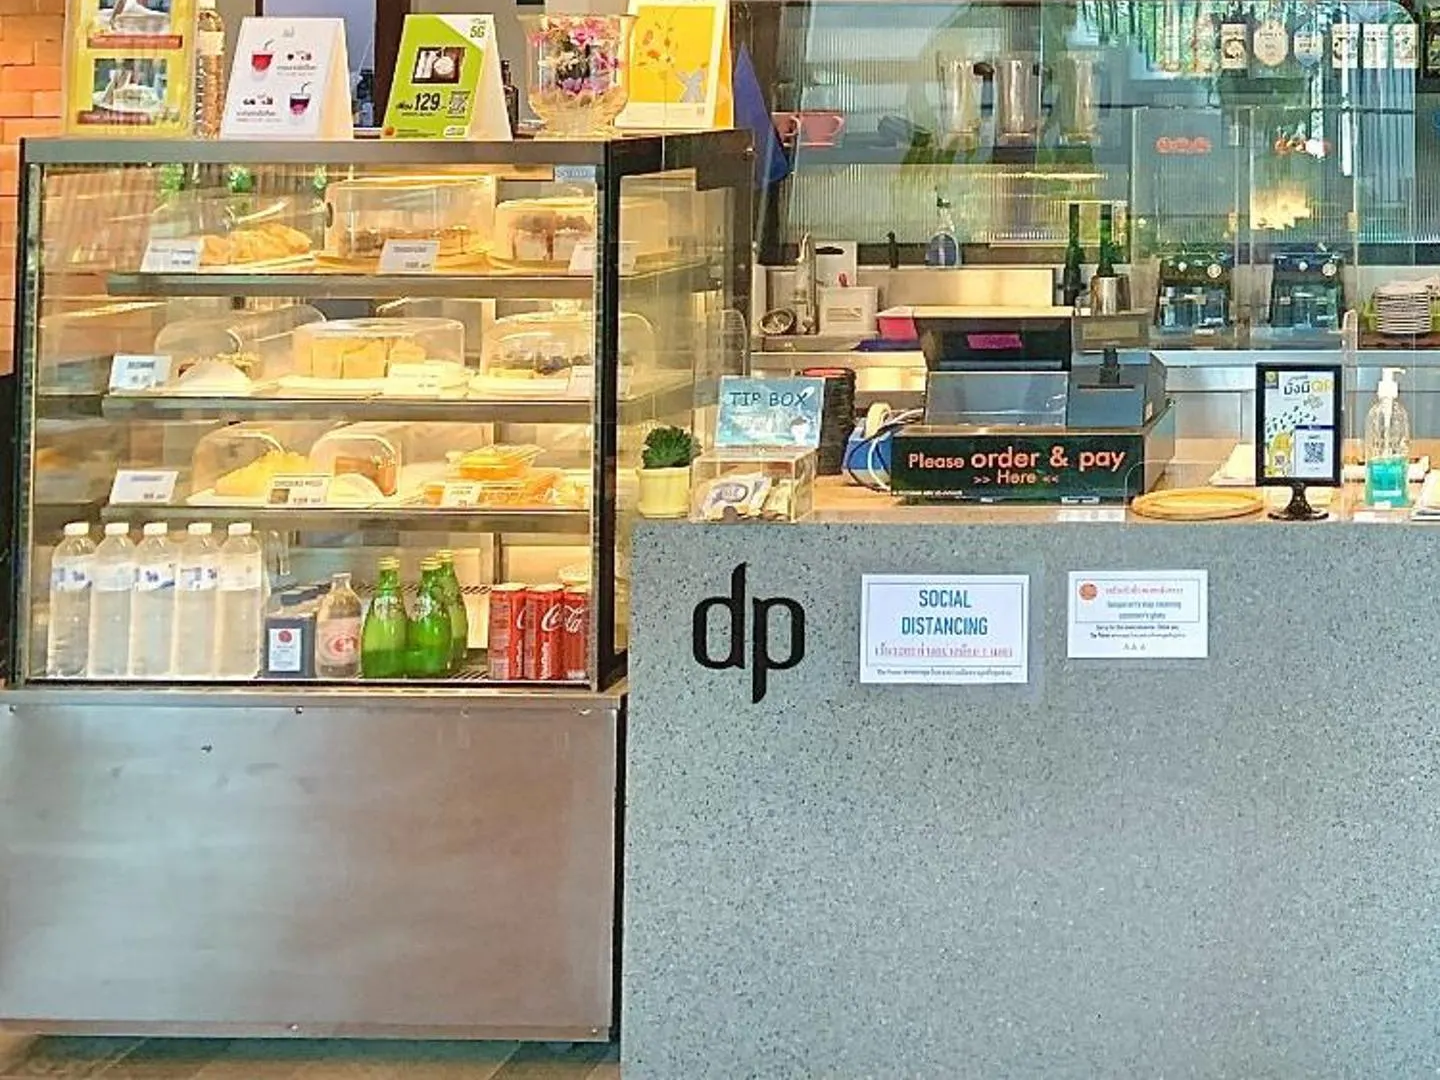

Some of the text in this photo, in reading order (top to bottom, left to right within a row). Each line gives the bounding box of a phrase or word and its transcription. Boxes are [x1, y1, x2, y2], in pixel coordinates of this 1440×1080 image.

[469, 26, 485, 38] 5G
[415, 92, 441, 111] 129
[729, 391, 808, 407] TIP BOX
[909, 446, 1126, 471] Please order & pay
[997, 471, 1037, 484] Here
[919, 590, 972, 608] SOCIAL
[693, 561, 805, 704] dp
[901, 616, 988, 635] DISTANCING
